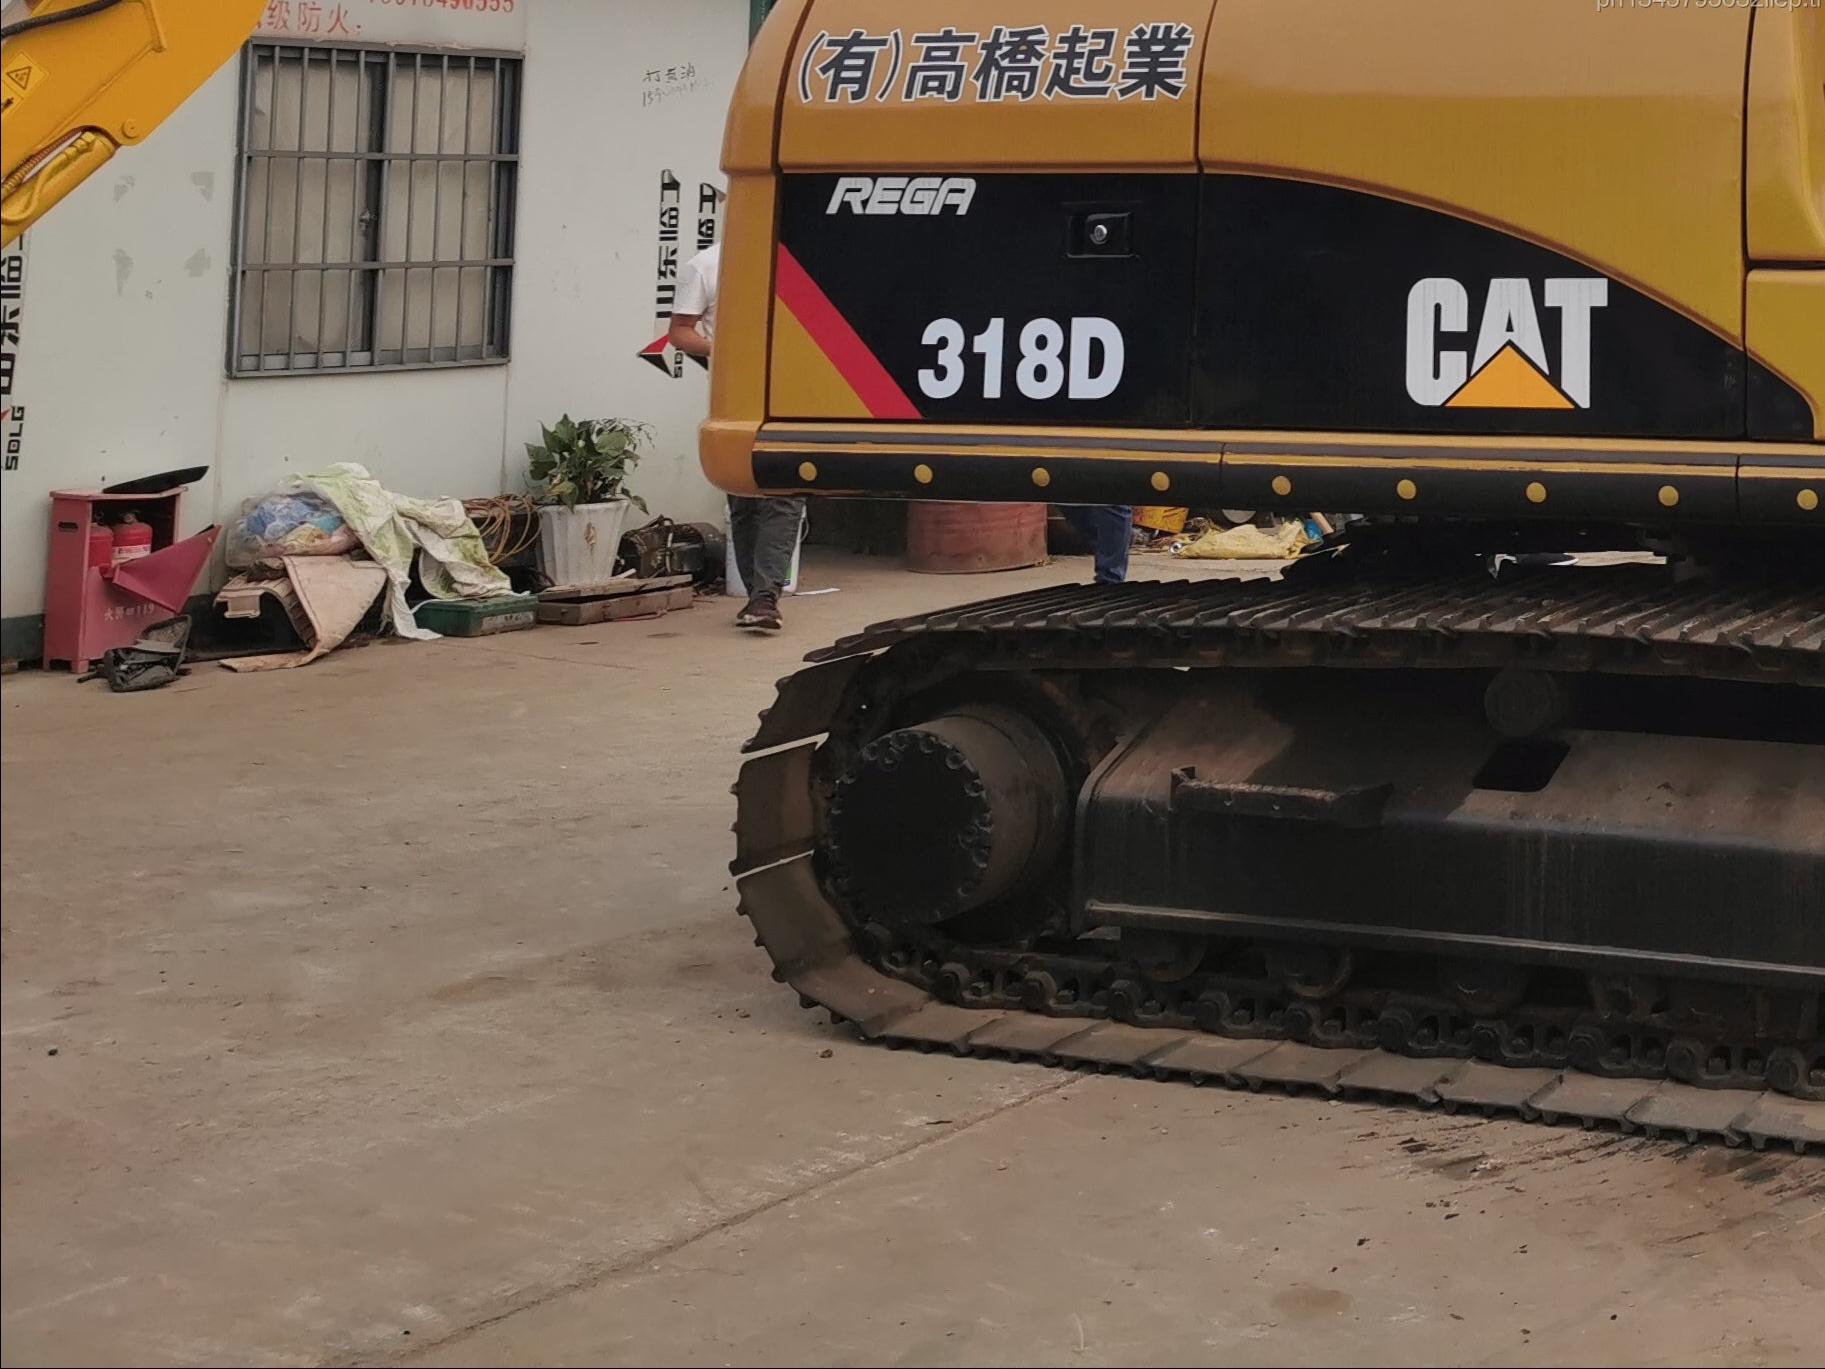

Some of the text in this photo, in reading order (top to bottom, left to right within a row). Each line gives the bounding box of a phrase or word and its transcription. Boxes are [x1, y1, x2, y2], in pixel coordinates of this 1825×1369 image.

[826, 177, 977, 216] REGA
[917, 317, 1125, 400] 318D
[1406, 277, 1609, 409] CAT
